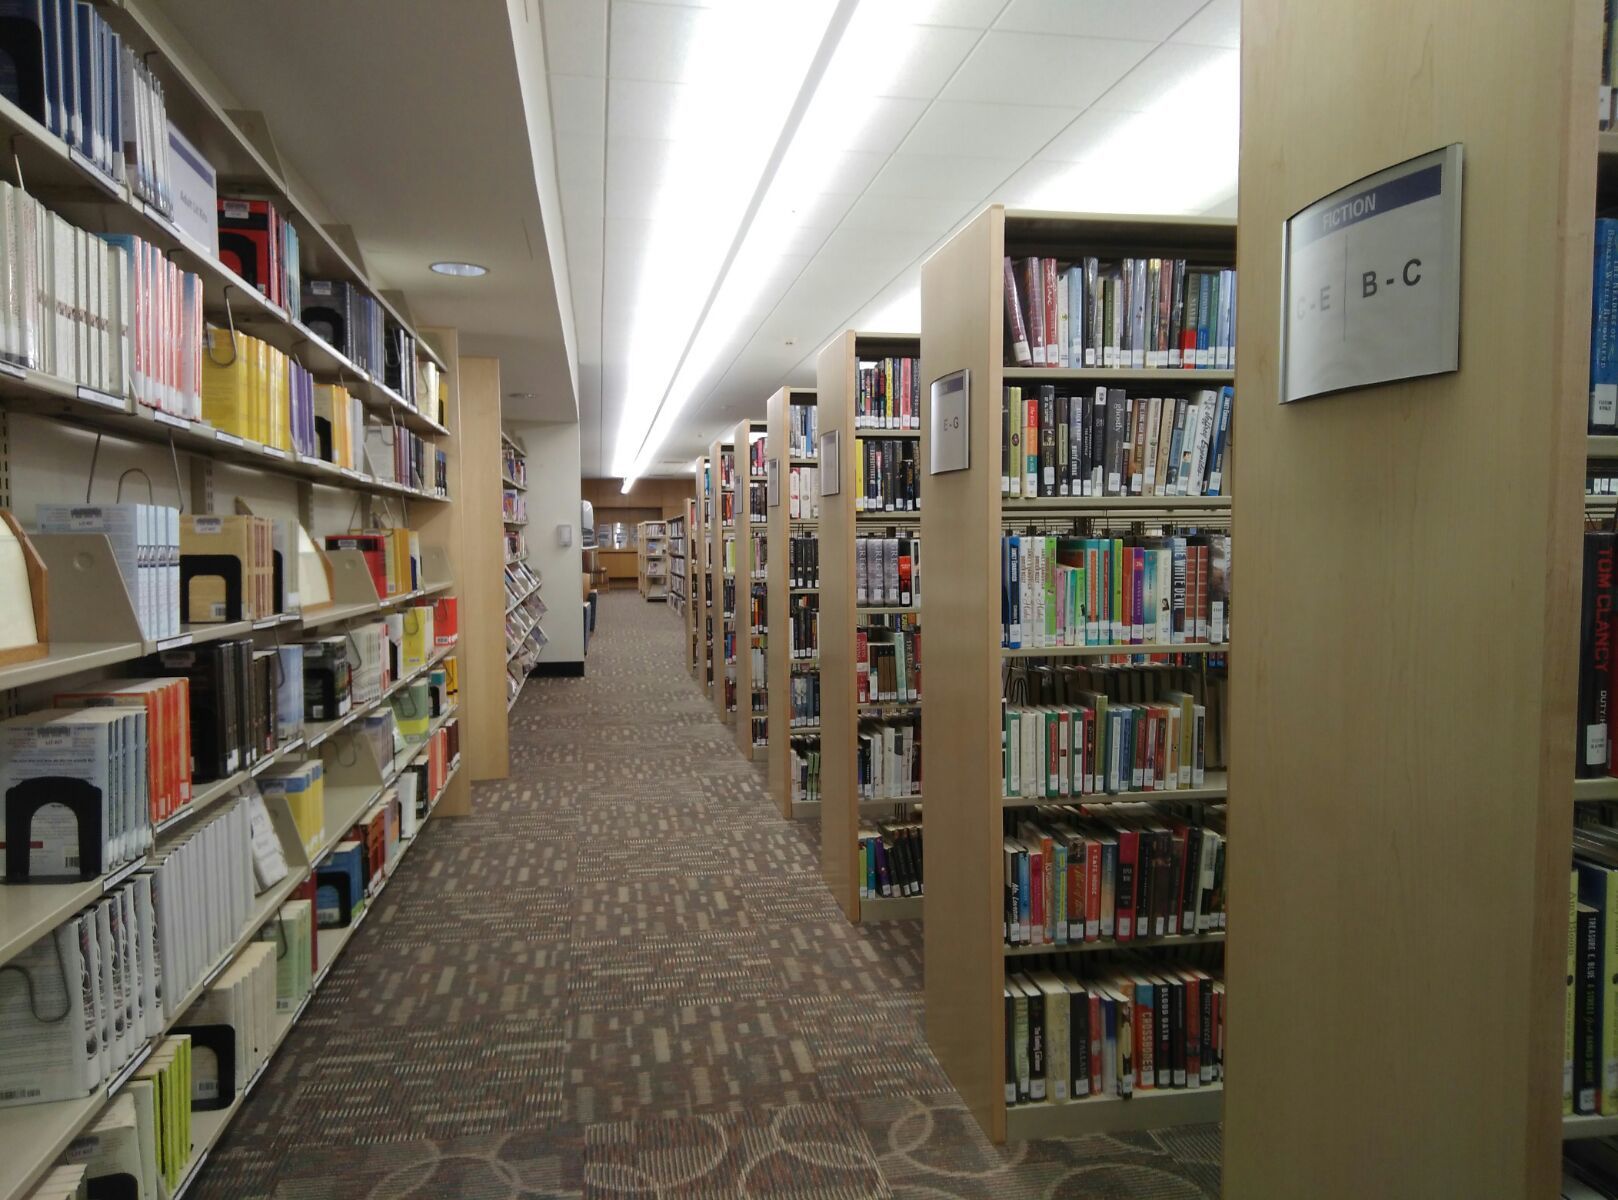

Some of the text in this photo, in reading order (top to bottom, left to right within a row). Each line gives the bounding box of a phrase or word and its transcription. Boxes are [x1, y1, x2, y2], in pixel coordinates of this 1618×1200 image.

[1321, 193, 1376, 231] FICTION
[1363, 270, 1377, 298] B
[1402, 258, 1422, 287] C
[1114, 403, 1124, 432] ghostly
[1197, 412, 1212, 477] Jeffrey Eugenides
[1174, 560, 1186, 585] WHITE
[1173, 587, 1185, 611] DEVIL
[1594, 547, 1613, 673] TOM CLANCY
[1600, 690, 1608, 715] DUTY
[1588, 917, 1597, 951] TREASURE
[1587, 961, 1596, 979] BLUE
[1034, 1035, 1042, 1051] Family
[1142, 1011, 1153, 1071] CROSSBONES
